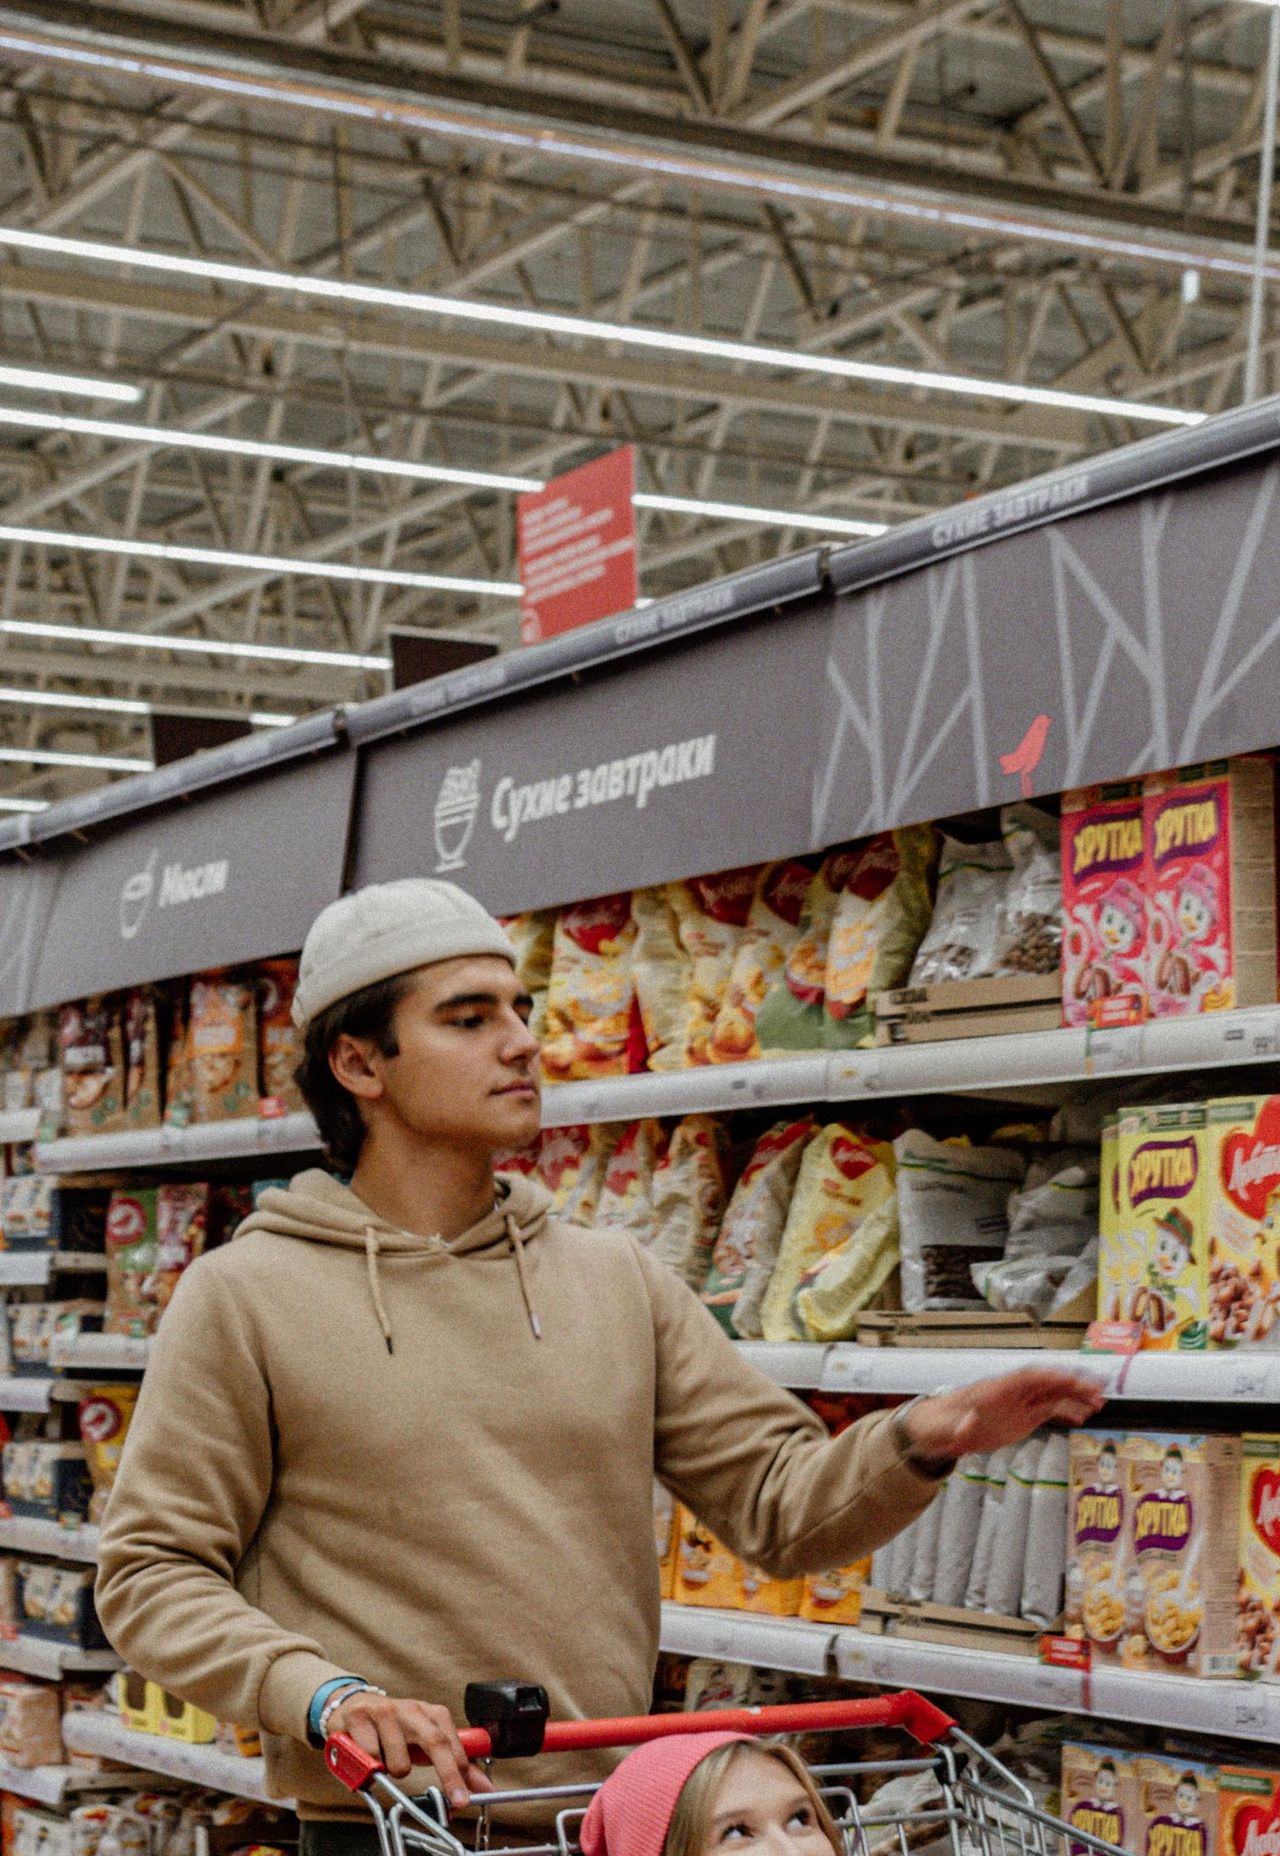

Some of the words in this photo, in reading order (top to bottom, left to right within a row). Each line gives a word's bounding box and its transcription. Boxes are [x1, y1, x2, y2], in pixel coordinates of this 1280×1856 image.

[491, 777, 571, 842] Сухие
[573, 735, 716, 808] завтраки
[1130, 1147, 1194, 1195] ХРУТКА
